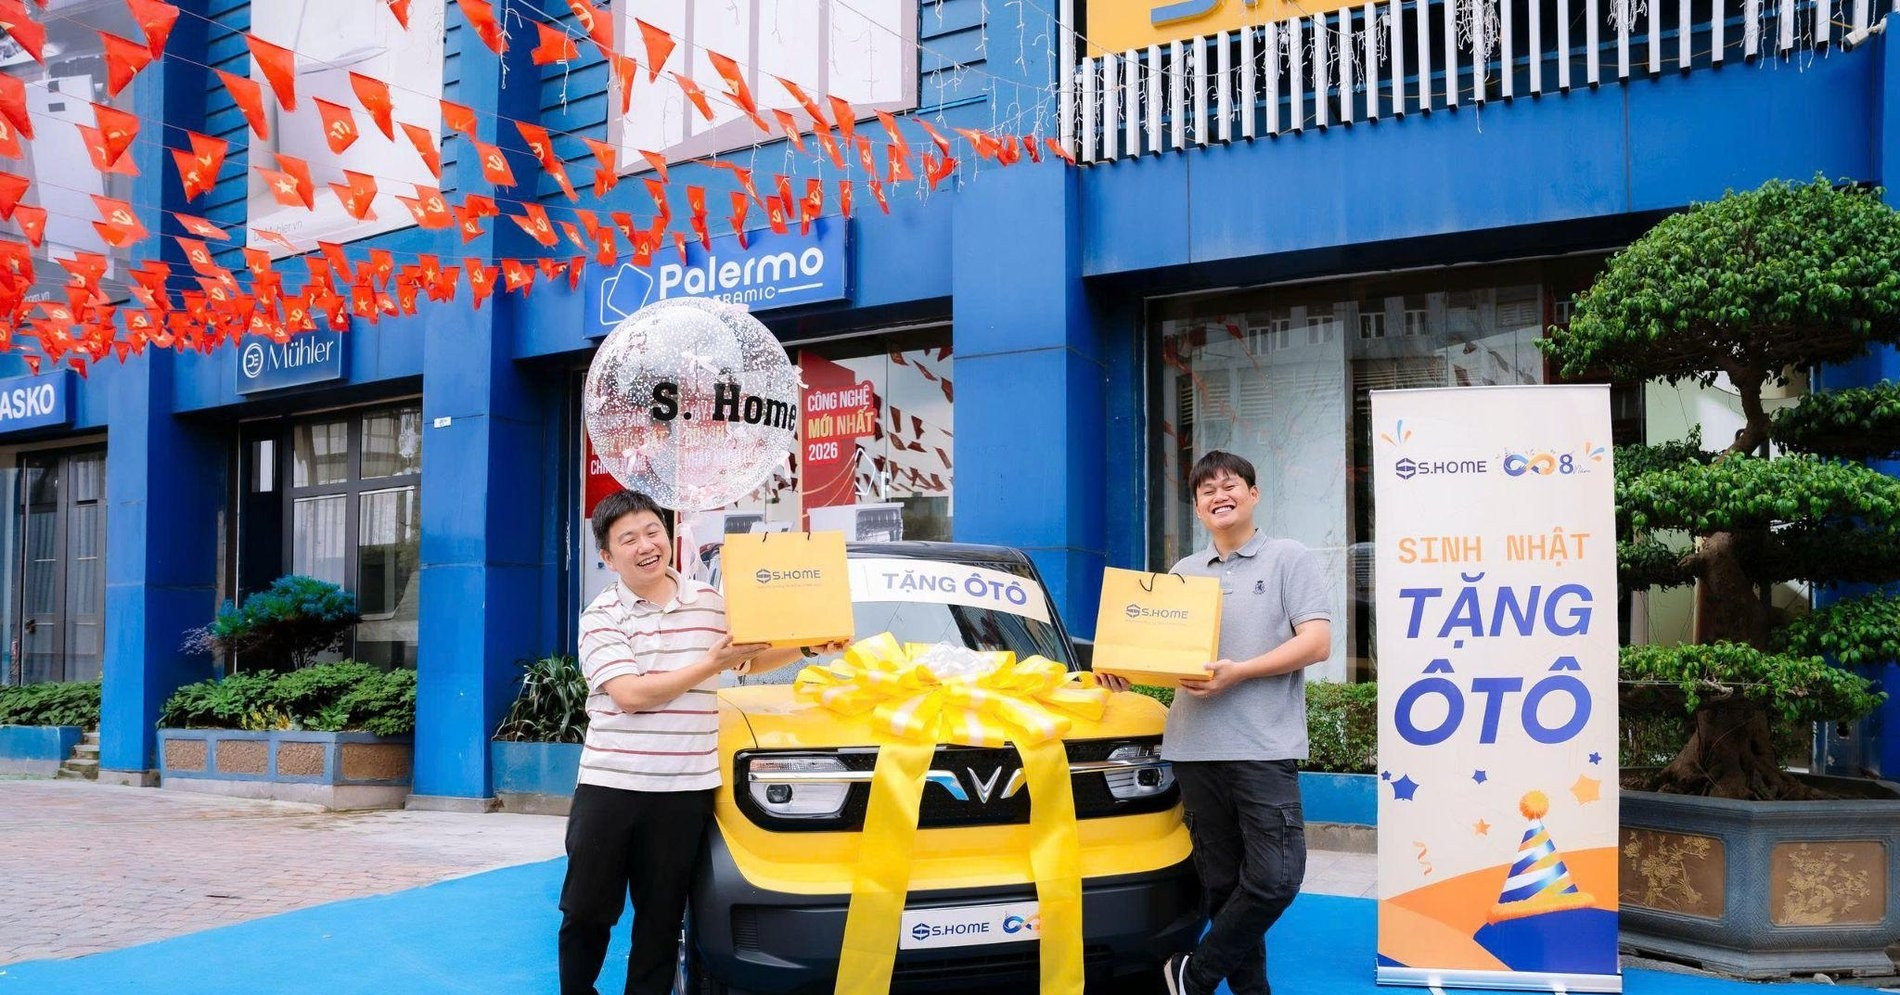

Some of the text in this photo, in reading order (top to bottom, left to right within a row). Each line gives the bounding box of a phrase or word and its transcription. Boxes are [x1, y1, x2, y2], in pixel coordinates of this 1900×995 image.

[659, 247, 824, 300] Palermo
[713, 286, 776, 304] RAMIC
[267, 336, 335, 372] Mühler
[0, 383, 55, 421] ASKO
[712, 383, 797, 431] Home
[807, 391, 838, 412] CÔNG
[808, 405, 875, 439] MỚI NHẤT
[808, 442, 838, 461] 2026
[1418, 460, 1488, 475] S.HOME
[1559, 454, 1574, 475] 8
[1398, 526, 1591, 567] SINH NHẬT
[772, 569, 822, 581] S.HOME
[882, 569, 1028, 606] TẶNG ÔTÔ
[1141, 607, 1189, 620] S.HOME
[1399, 571, 1594, 649] TẶNG
[1394, 656, 1593, 746] ÔTÔ
[931, 922, 990, 936] S.HOME
